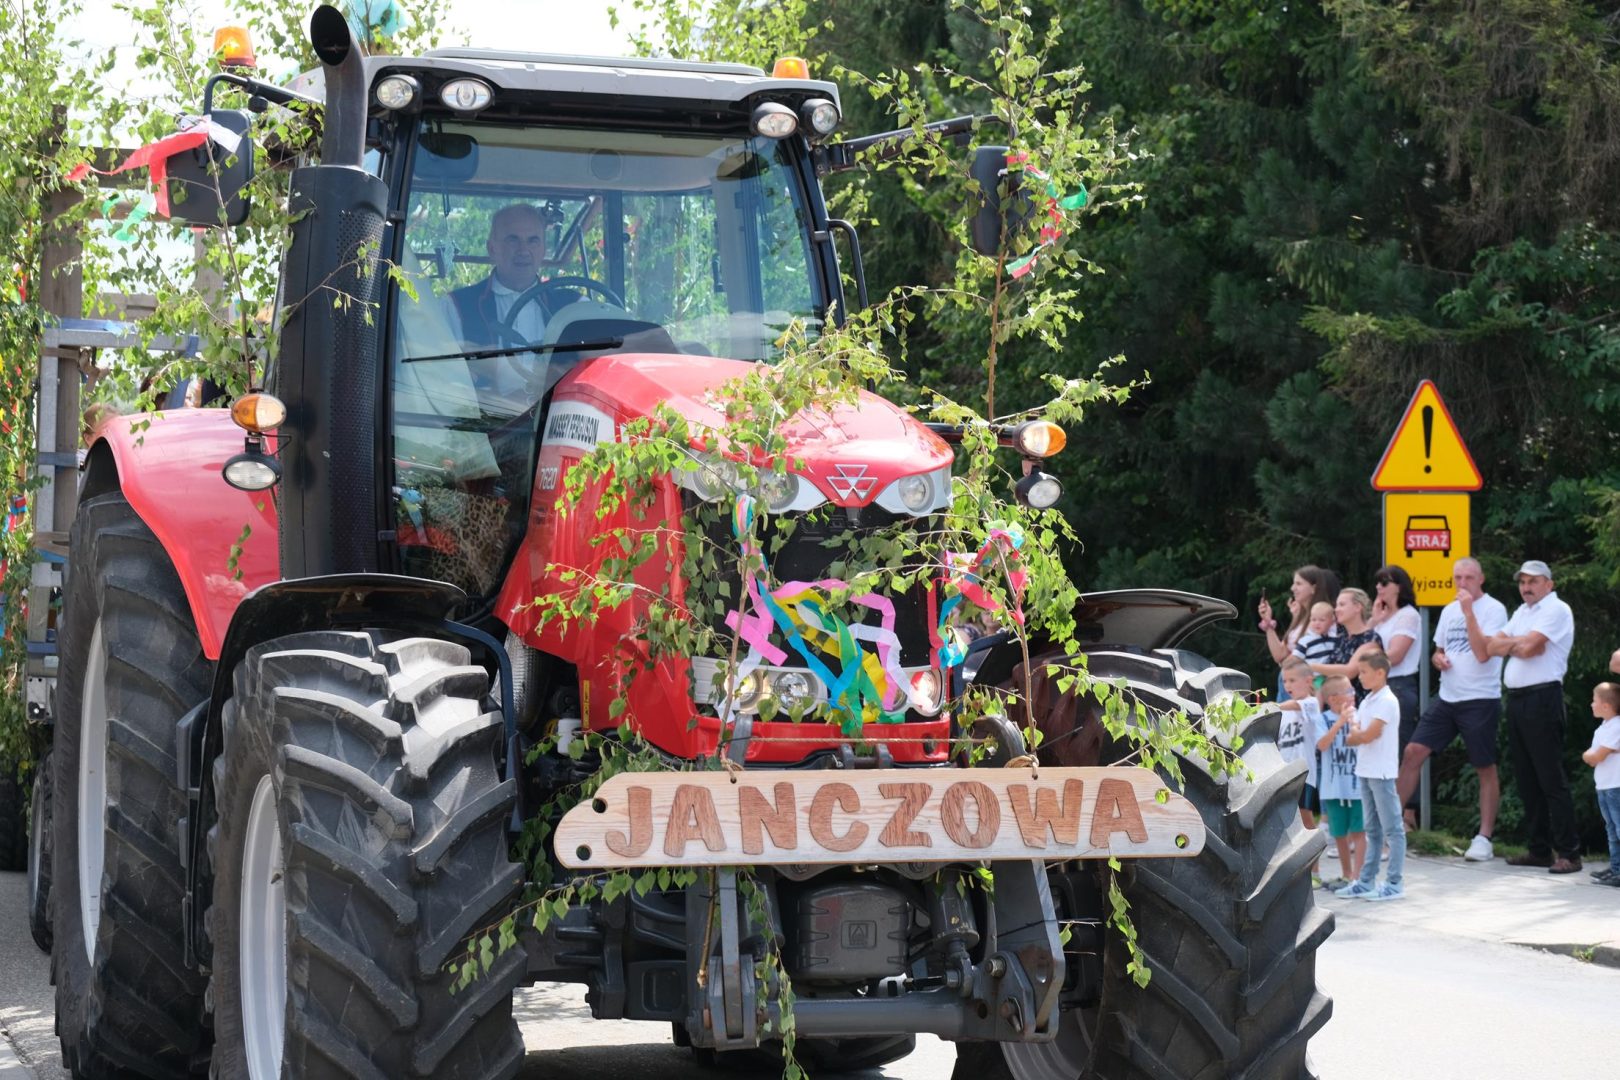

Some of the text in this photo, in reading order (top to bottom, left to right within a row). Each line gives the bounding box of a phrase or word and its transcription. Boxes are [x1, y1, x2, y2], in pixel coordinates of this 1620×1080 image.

[547, 413, 599, 446] MASSEY FERGUSON
[1407, 531, 1448, 548] STRAŻ
[605, 778, 1149, 858] JANCZOWA
